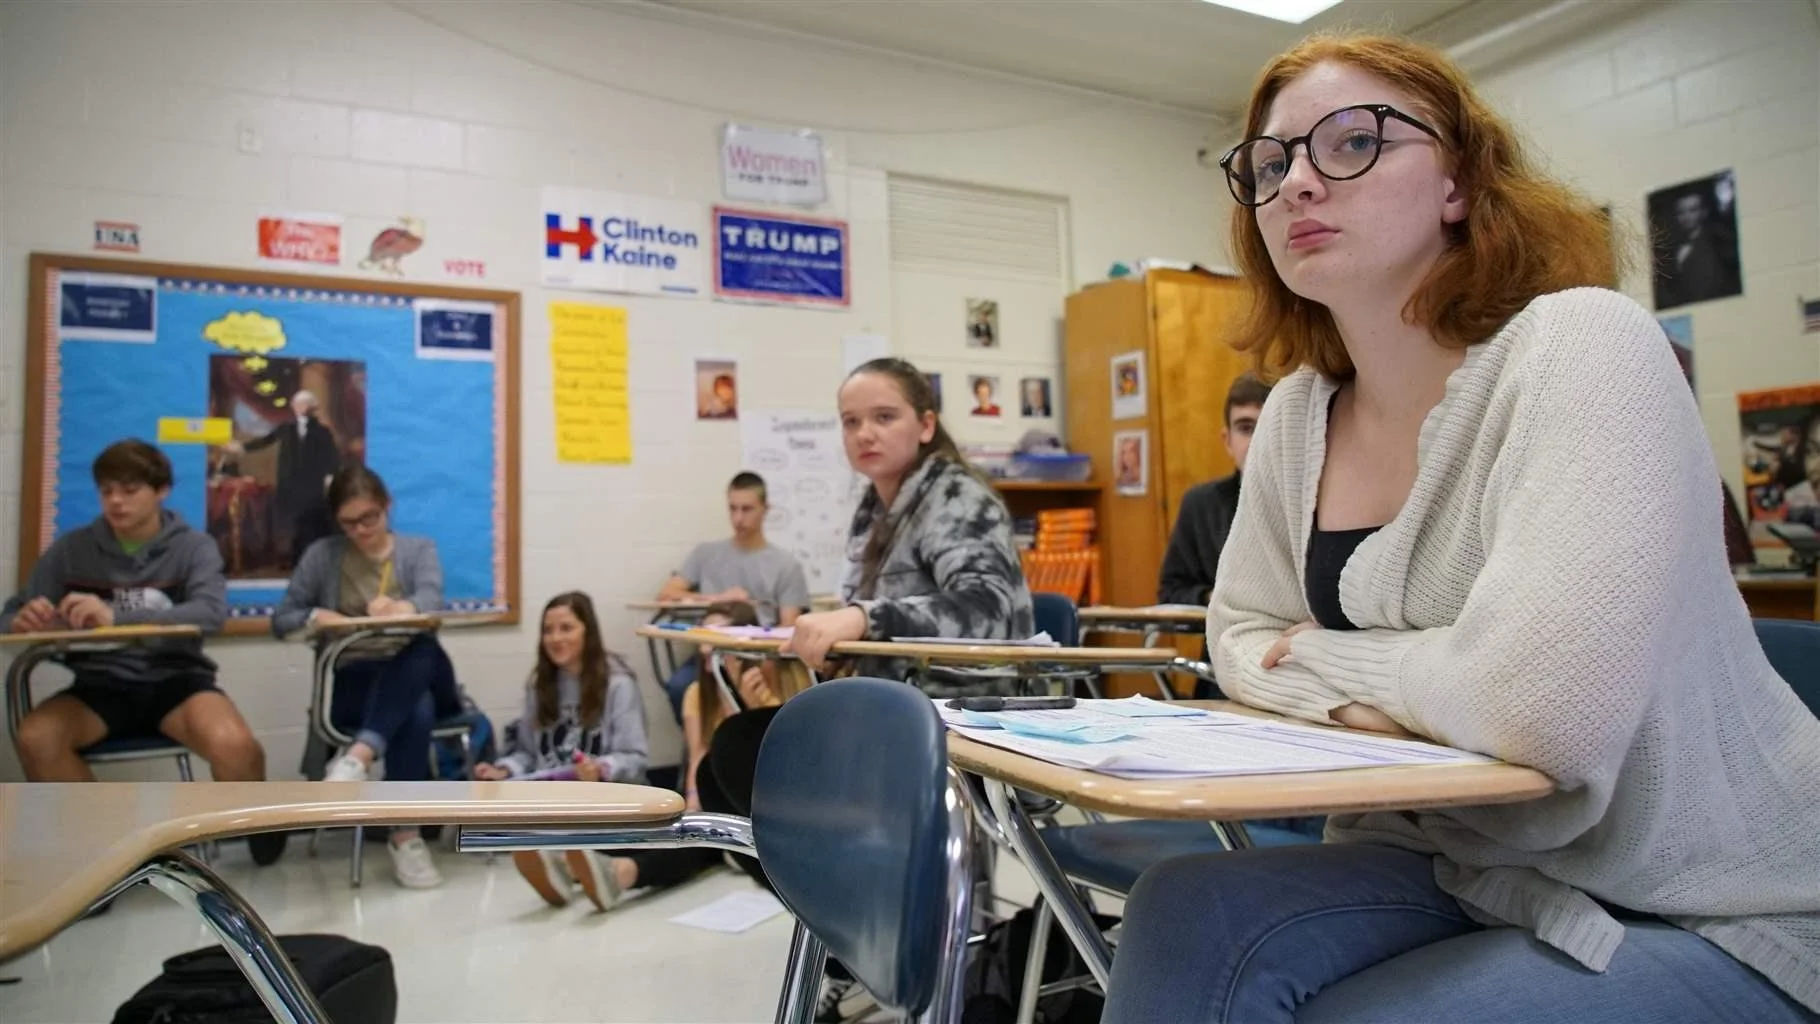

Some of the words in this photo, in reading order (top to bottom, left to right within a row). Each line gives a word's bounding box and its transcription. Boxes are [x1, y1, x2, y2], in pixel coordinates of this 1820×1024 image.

[728, 145, 817, 177] Women
[603, 217, 698, 248] Clinton
[722, 225, 839, 256] TRUMP
[442, 260, 487, 279] VOTE
[603, 243, 677, 270] Kaine
